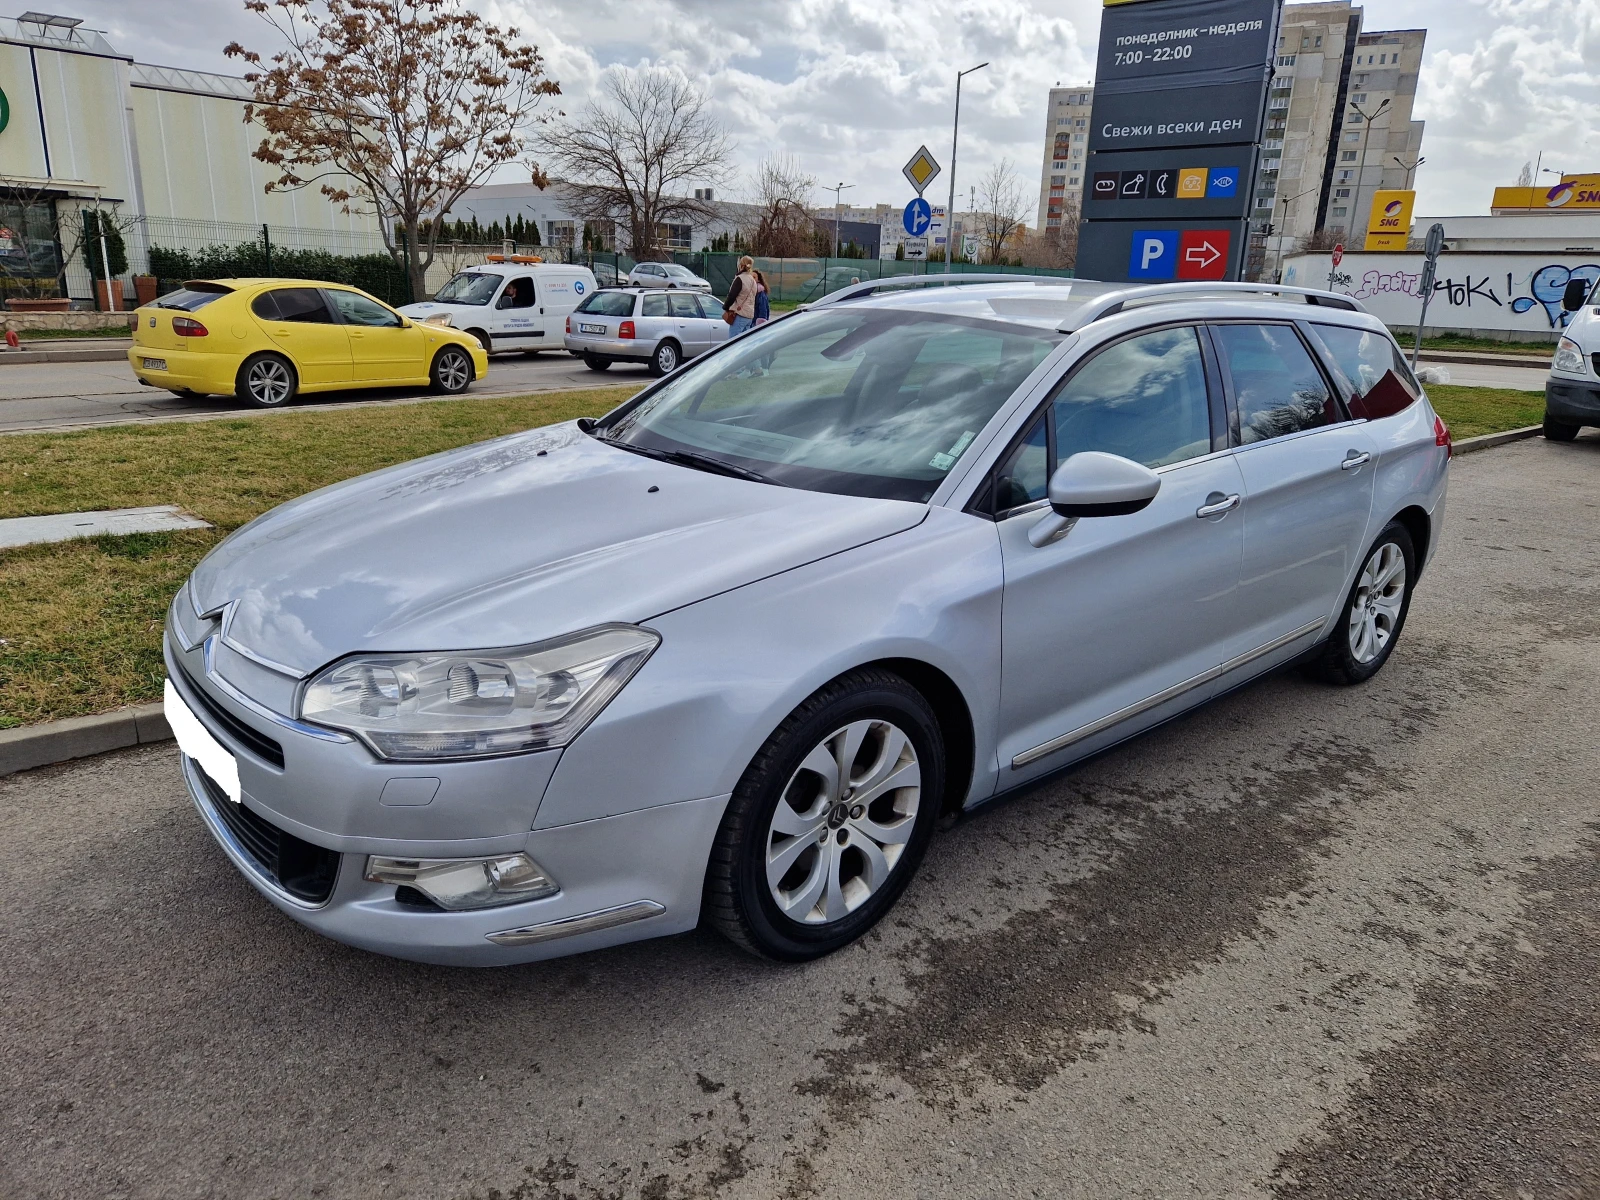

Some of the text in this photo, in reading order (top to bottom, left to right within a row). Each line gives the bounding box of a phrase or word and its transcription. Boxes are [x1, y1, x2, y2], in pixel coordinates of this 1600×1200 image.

[1102, 118, 1243, 138] Свежи всеки ден
[1576, 190, 1600, 203] SN
[931, 206, 944, 214] dm
[1379, 218, 1400, 227] SNG
[1140, 238, 1164, 270] P
